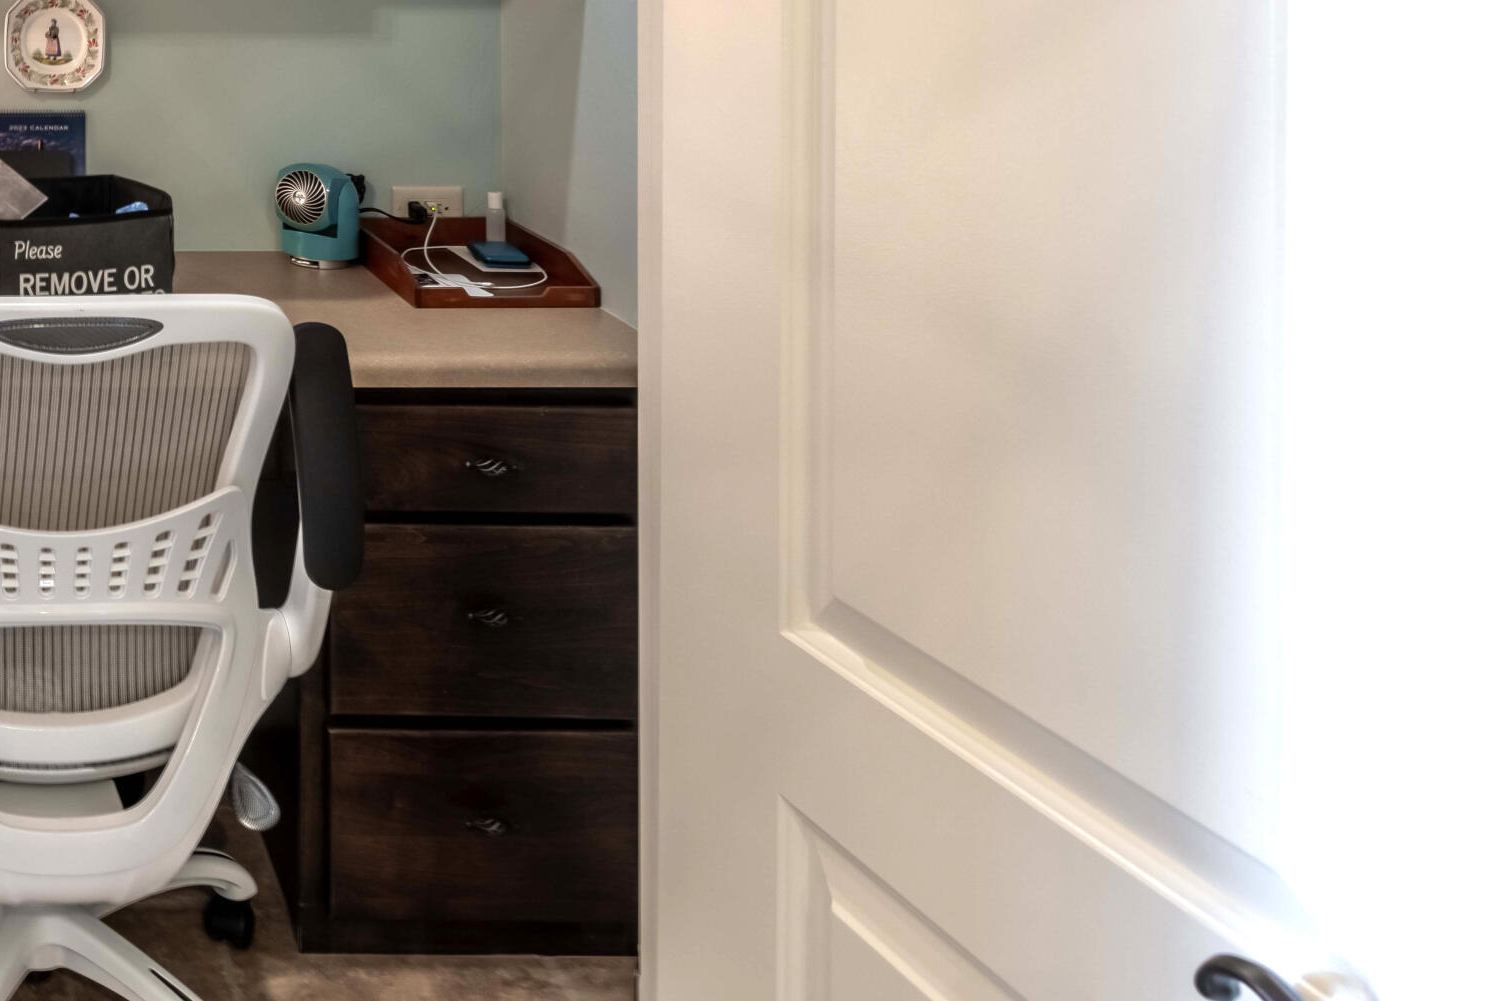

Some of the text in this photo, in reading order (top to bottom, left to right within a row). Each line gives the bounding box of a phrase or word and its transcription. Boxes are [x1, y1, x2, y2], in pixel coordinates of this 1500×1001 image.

[29, 124, 69, 132] CALENDAR
[14, 239, 63, 260] Please
[19, 264, 155, 296] REMOVE OR
